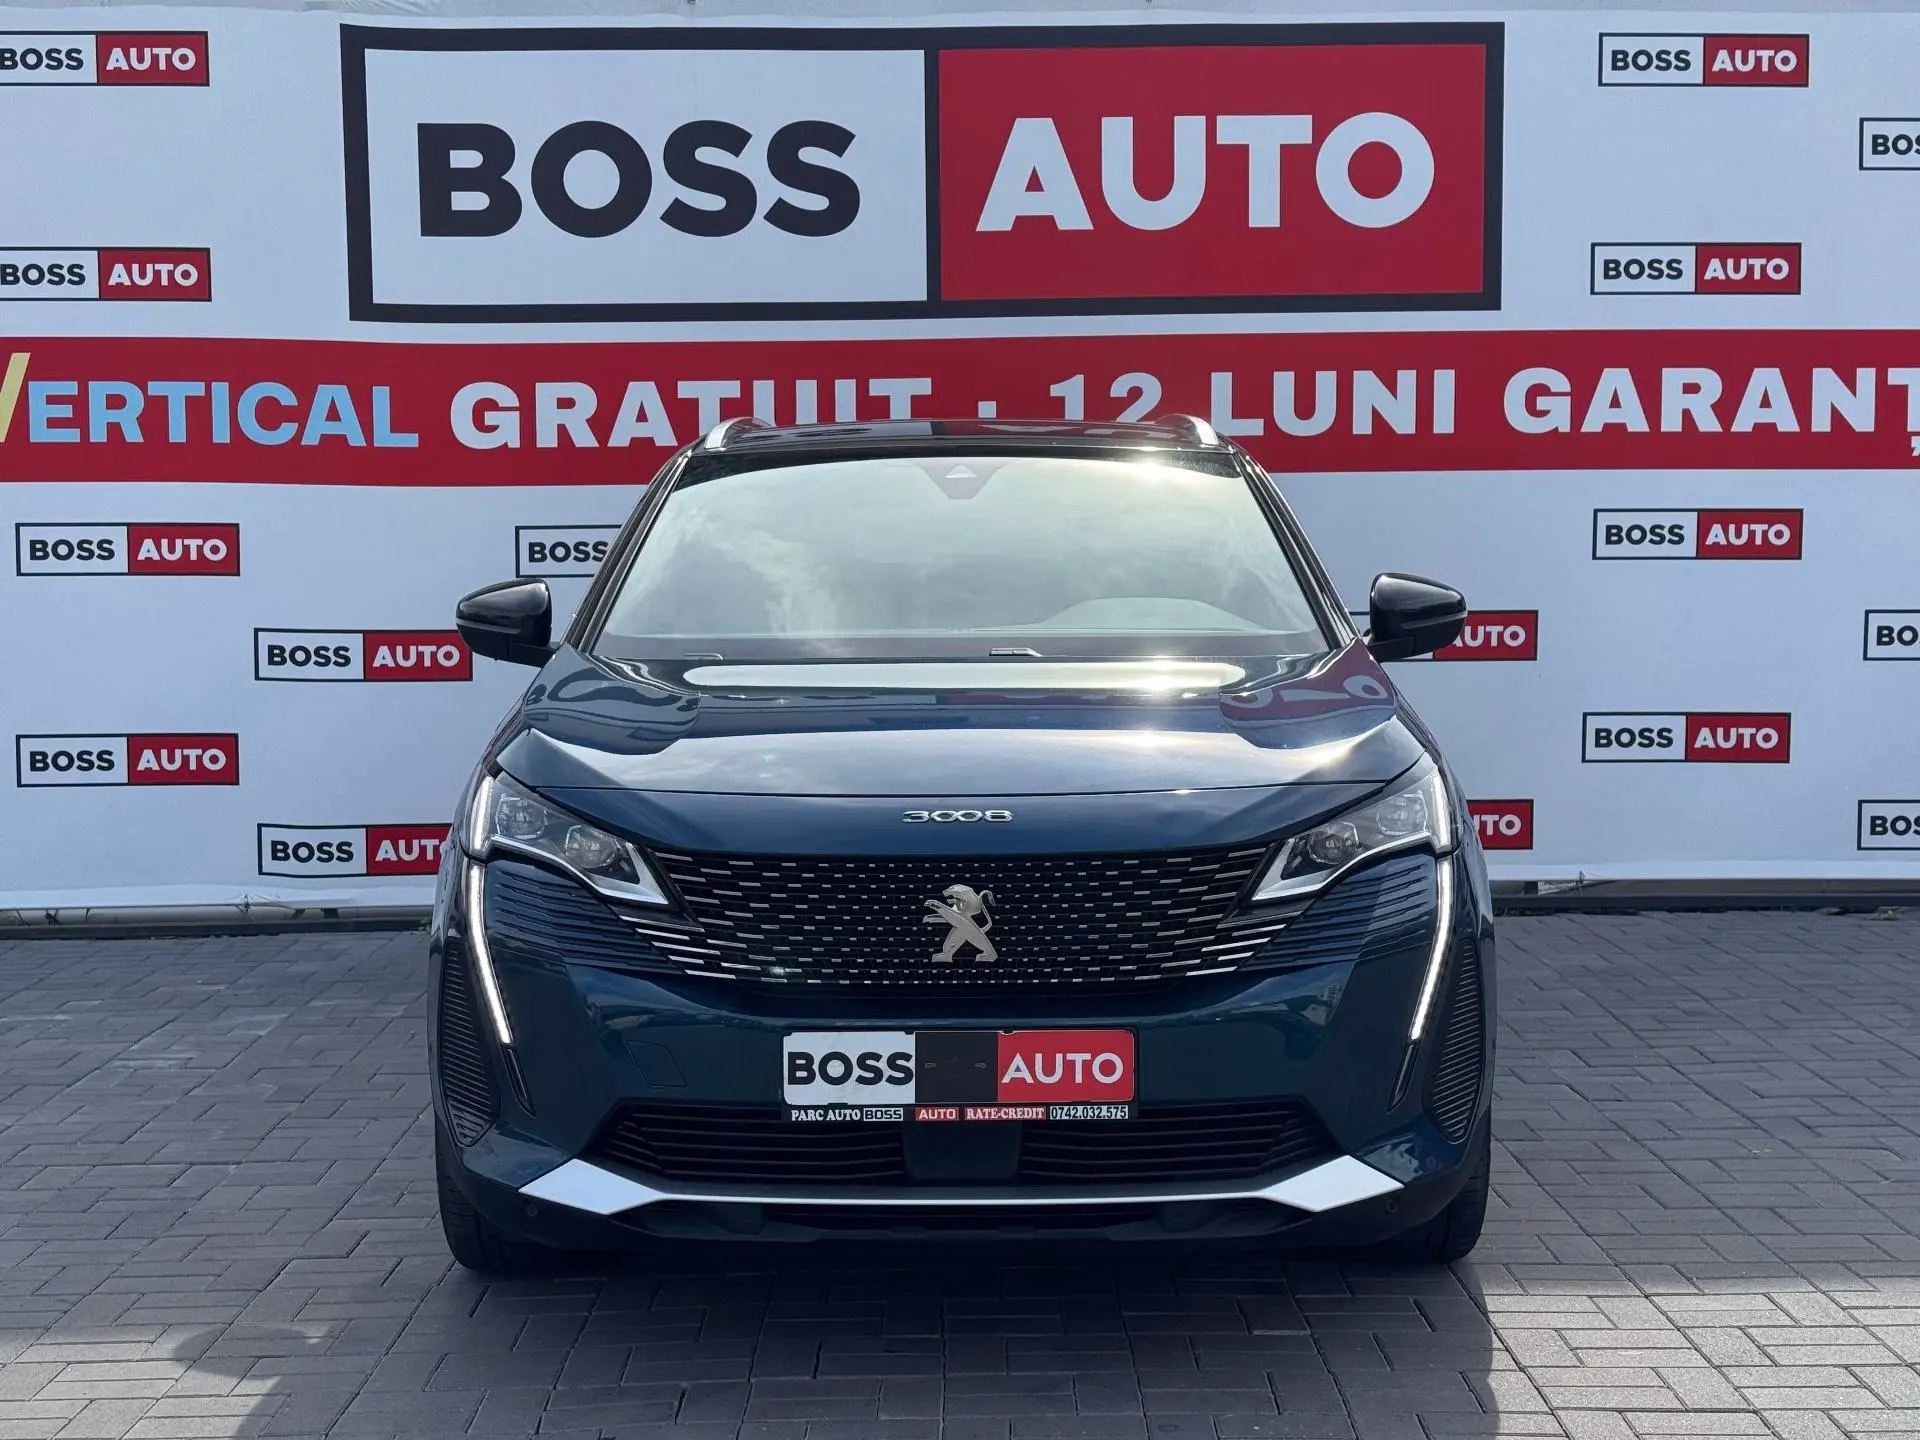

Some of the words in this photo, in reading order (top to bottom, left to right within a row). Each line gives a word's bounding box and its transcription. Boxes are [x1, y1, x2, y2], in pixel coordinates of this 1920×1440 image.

[0, 48, 83, 70] BOSS
[106, 48, 196, 70] AUTO
[1610, 50, 1691, 72] BOSS
[1712, 50, 1797, 72] AUTO
[417, 120, 860, 238] BOSS
[976, 112, 1434, 231] AUTO
[0, 264, 86, 286] BOSS
[108, 264, 198, 286] AUTO
[1603, 258, 1683, 280] BOSS
[1704, 258, 1789, 280] AUTO
[450, 378, 932, 449] GRATUIT
[1050, 372, 1162, 424] 12
[1211, 370, 1455, 436] LUNI
[1605, 523, 1684, 545] BOSS
[1705, 523, 1790, 546] AUTO
[29, 539, 115, 561] BOSS
[137, 539, 227, 561] AUTO
[528, 541, 609, 562] BOSS
[267, 645, 351, 667] BOSS
[373, 645, 460, 667] AUTO
[1594, 728, 1673, 748] BOSS
[1694, 728, 1778, 749] AUTO
[29, 750, 115, 772] BOSS
[137, 749, 226, 771] AUTO
[902, 810, 1013, 823] 3008
[271, 840, 354, 863] BOSS
[376, 839, 447, 861] AUT
[787, 1052, 914, 1086] BOSS
[1001, 1053, 1123, 1084] AUTO
[791, 1109, 824, 1121] PARC
[826, 1109, 861, 1121] AUTO
[864, 1109, 903, 1121] BOSS
[918, 1108, 957, 1120] AUTO
[1050, 1106, 1127, 1119] 0742.032.575
